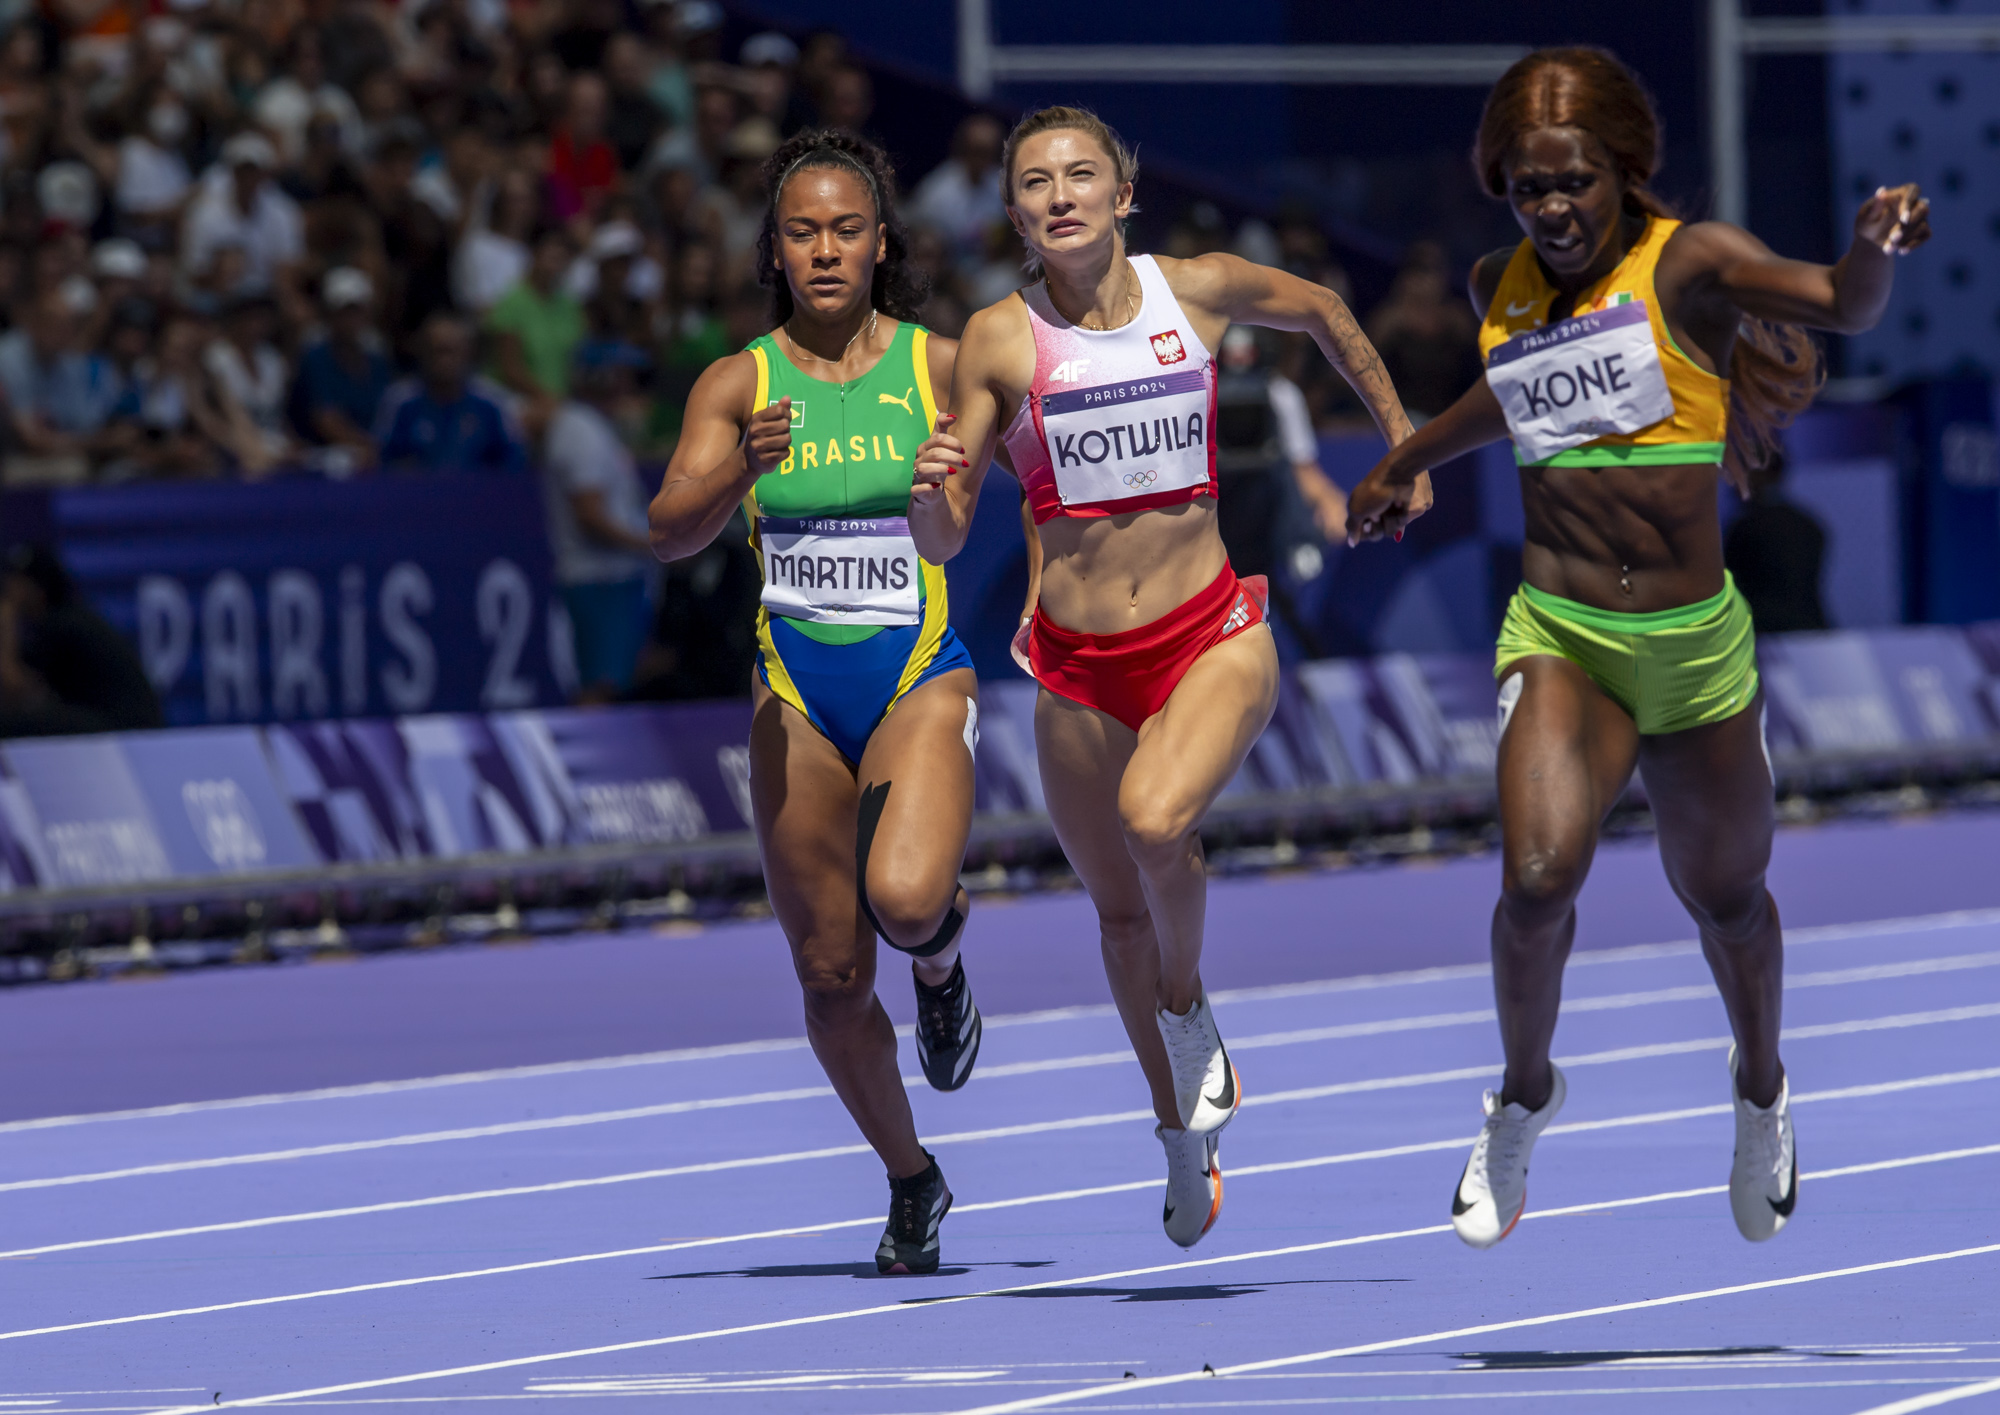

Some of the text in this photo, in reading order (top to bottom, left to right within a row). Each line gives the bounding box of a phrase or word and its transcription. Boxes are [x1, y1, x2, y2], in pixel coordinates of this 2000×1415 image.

[1522, 317, 1600, 351] PARIS 2024
[1085, 381, 1166, 403] PARIS 2024
[1521, 353, 1631, 416] KONE
[780, 434, 904, 475] BRASIL
[1054, 411, 1203, 468] KOTWILA
[800, 520, 877, 531] PARIS 2024
[770, 553, 909, 590] MARTINS
[136, 562, 438, 718] PARIS
